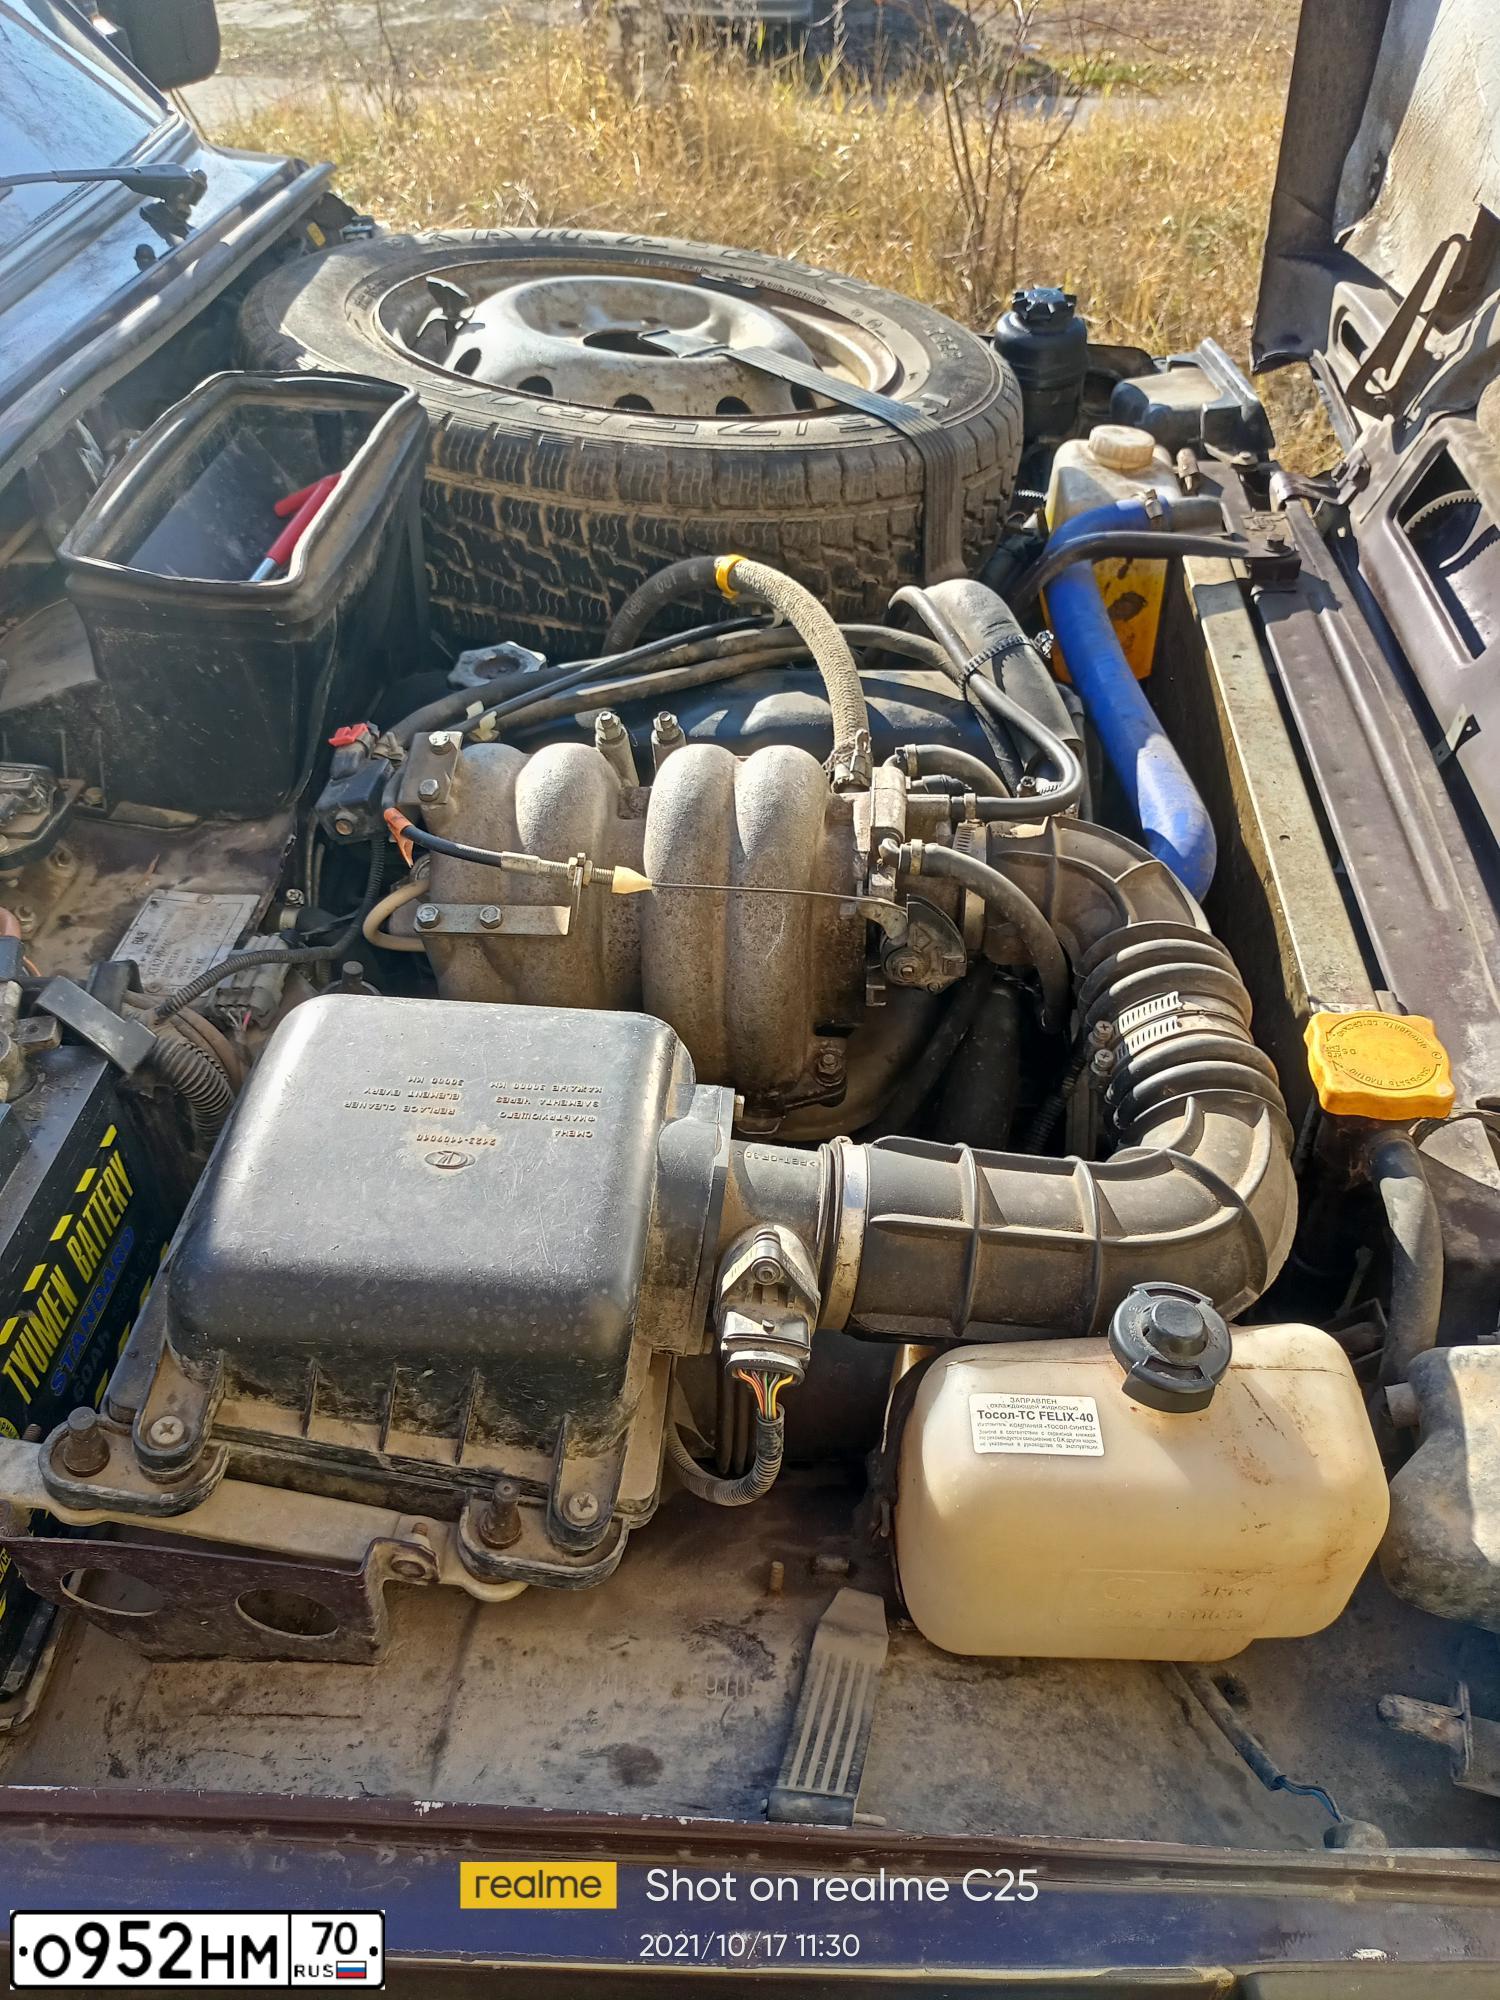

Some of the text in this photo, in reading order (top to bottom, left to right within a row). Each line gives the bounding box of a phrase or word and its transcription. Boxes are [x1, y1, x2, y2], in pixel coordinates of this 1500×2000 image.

[364, 1087, 460, 1101] ELEMENT EVERY
[495, 1096, 531, 1106] ЧЕРЕЗ
[344, 1101, 456, 1116] REPLACE CLEANER
[499, 1111, 596, 1123] ФИЛЬТРУЮЩЕГО
[554, 1129, 593, 1139] СМЕНА
[2, 1150, 135, 1405] TYUMEN BATTERY
[51, 1226, 136, 1396] STANDARD
[977, 1410, 1094, 1422] Тосол-ТС FELIX-40
